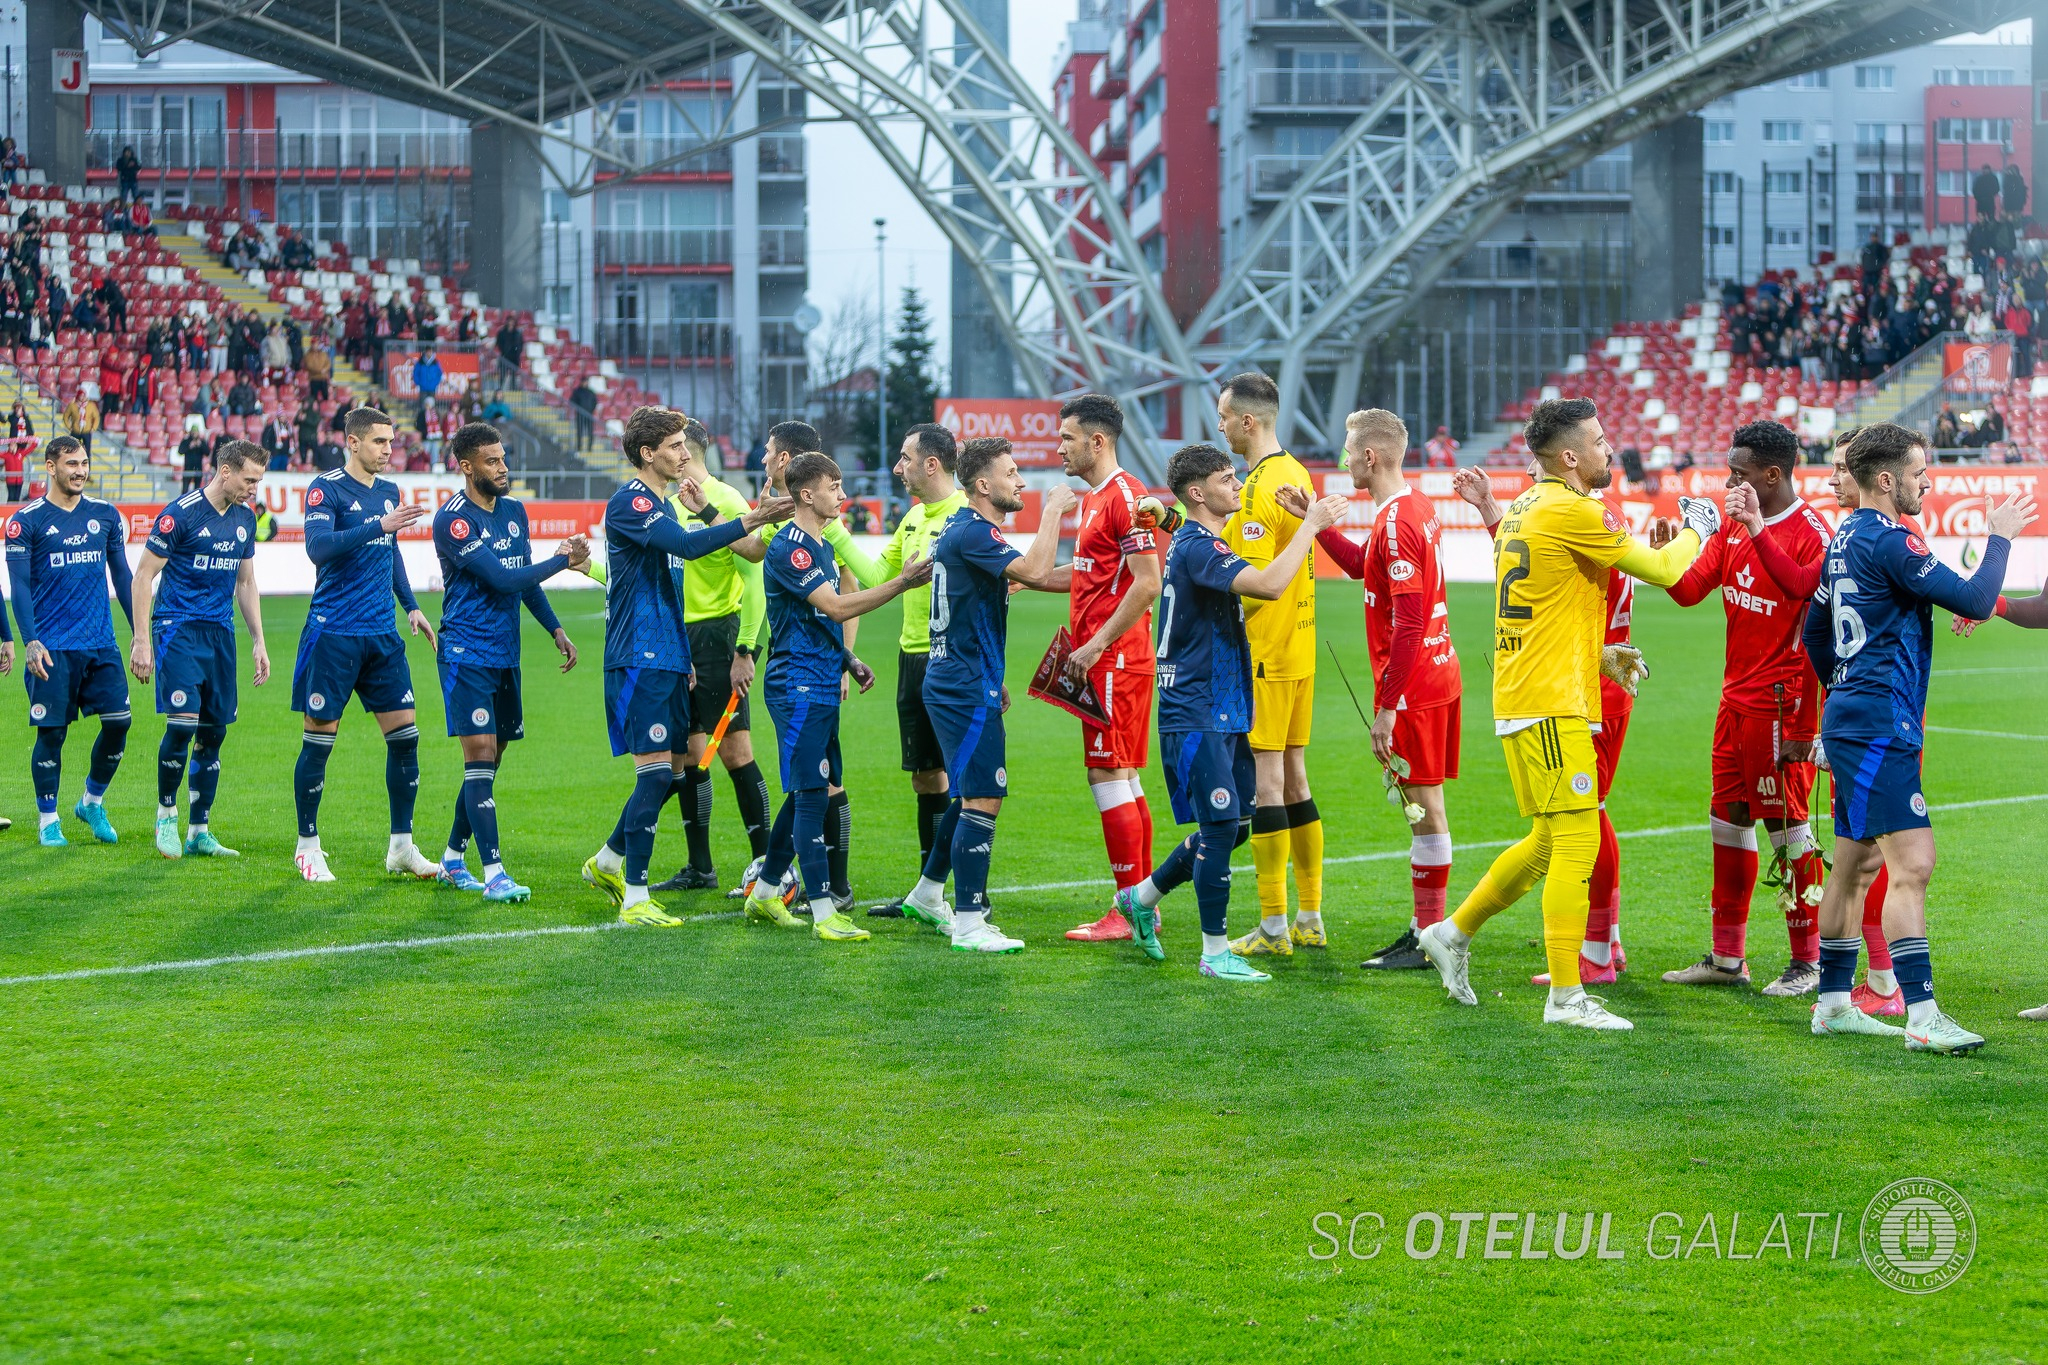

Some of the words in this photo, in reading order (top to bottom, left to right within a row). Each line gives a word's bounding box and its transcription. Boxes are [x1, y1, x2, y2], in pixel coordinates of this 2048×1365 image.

[61, 60, 81, 90] J
[962, 412, 1016, 437] DIVA
[1020, 412, 1059, 437] SOL
[1935, 475, 2038, 496] FAVBET
[1244, 526, 1260, 536] CBA
[66, 551, 102, 564] LIBERTY
[1392, 565, 1409, 576] CBA
[929, 562, 950, 633] 0
[1829, 578, 1868, 659] 6
[1094, 732, 1103, 750] 4
[1757, 776, 1777, 796] 40
